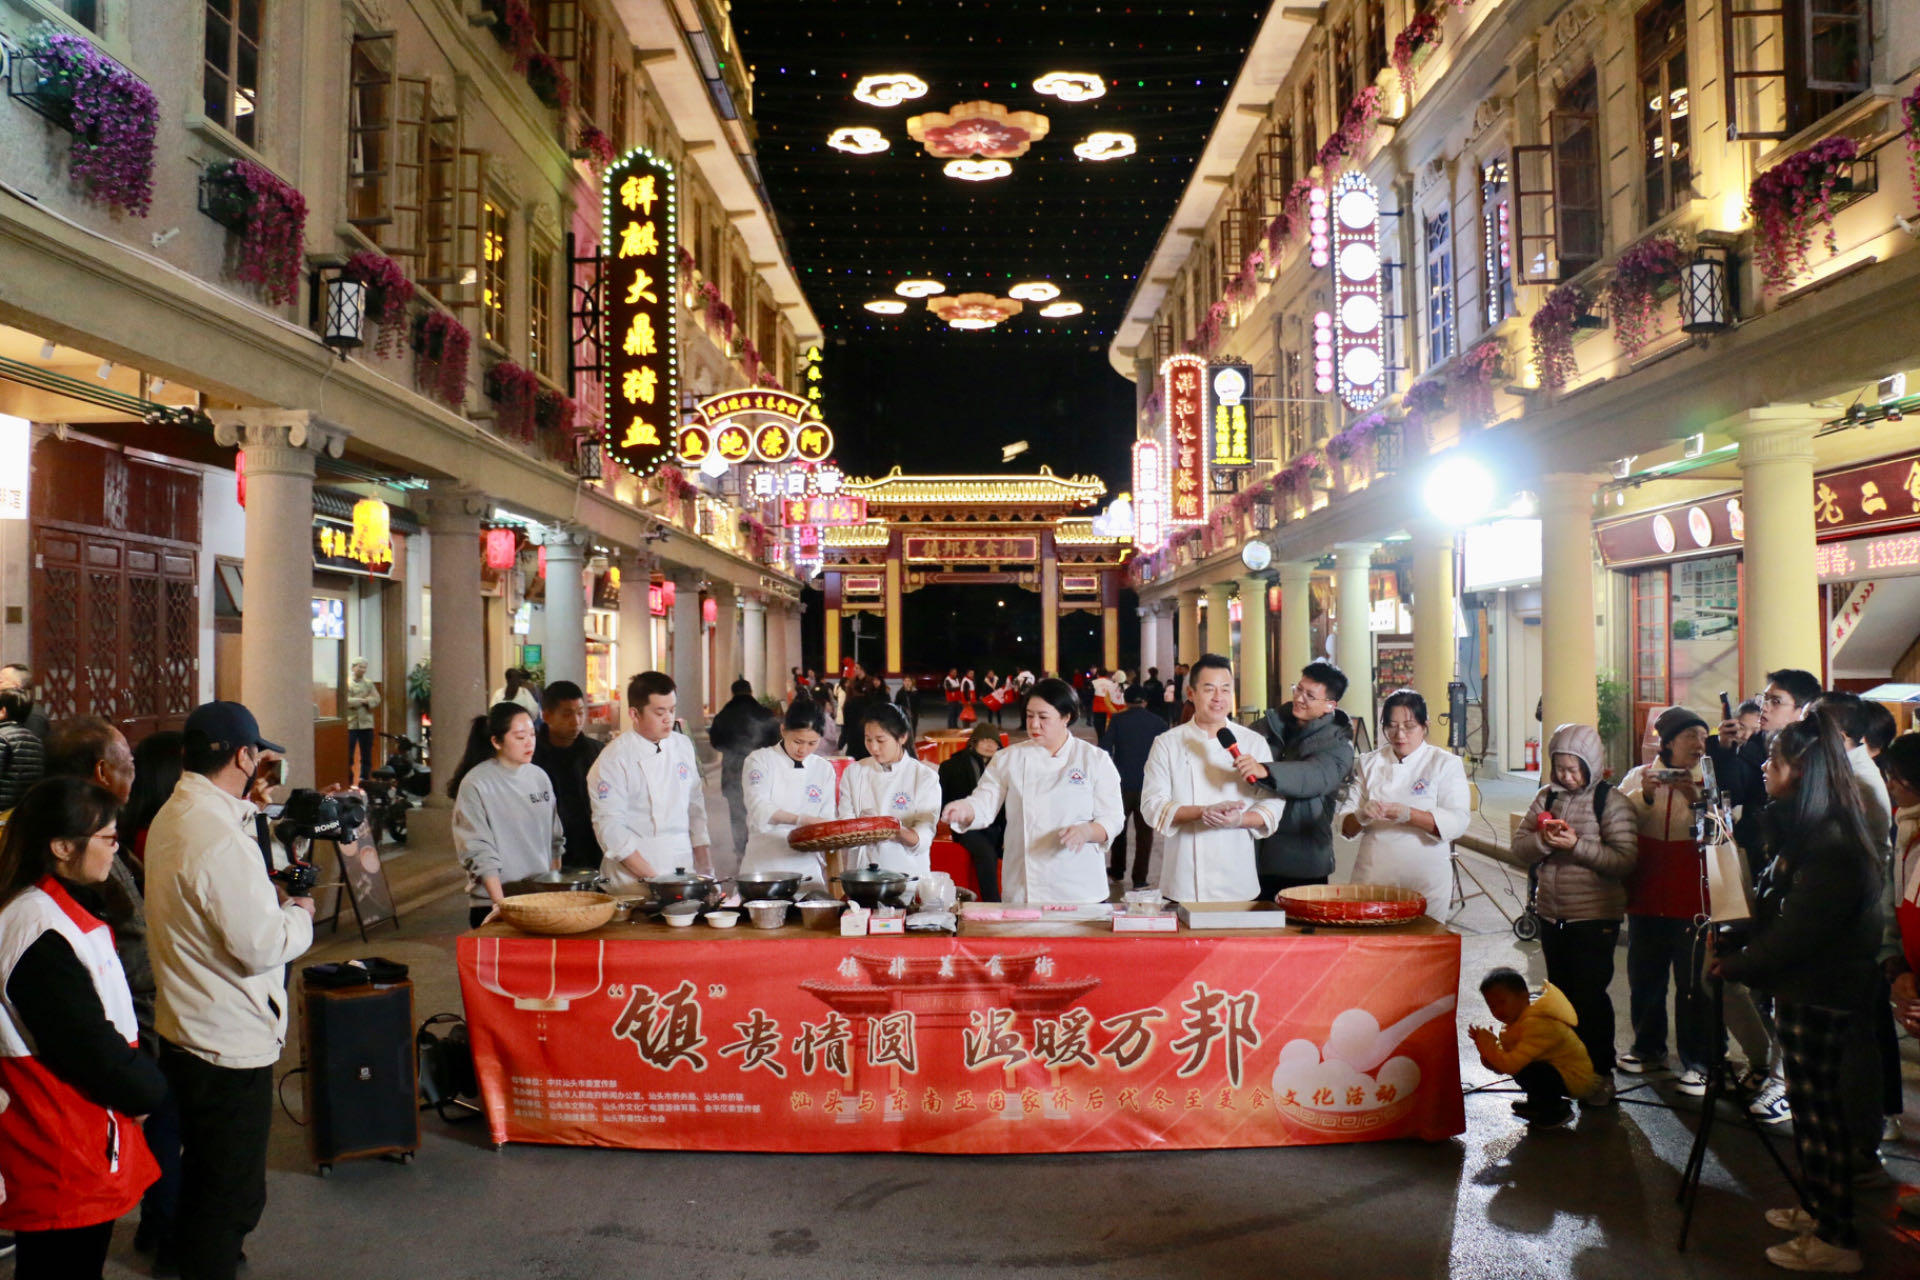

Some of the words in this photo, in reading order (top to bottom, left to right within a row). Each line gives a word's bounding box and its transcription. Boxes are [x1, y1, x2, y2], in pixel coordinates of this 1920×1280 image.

[314, 820, 340, 833] RONIN
[963, 980, 1264, 1088] 温暖万邦
[789, 1083, 1398, 1114] 汕头与东南亚国家侨后代冬至美食文化活动
